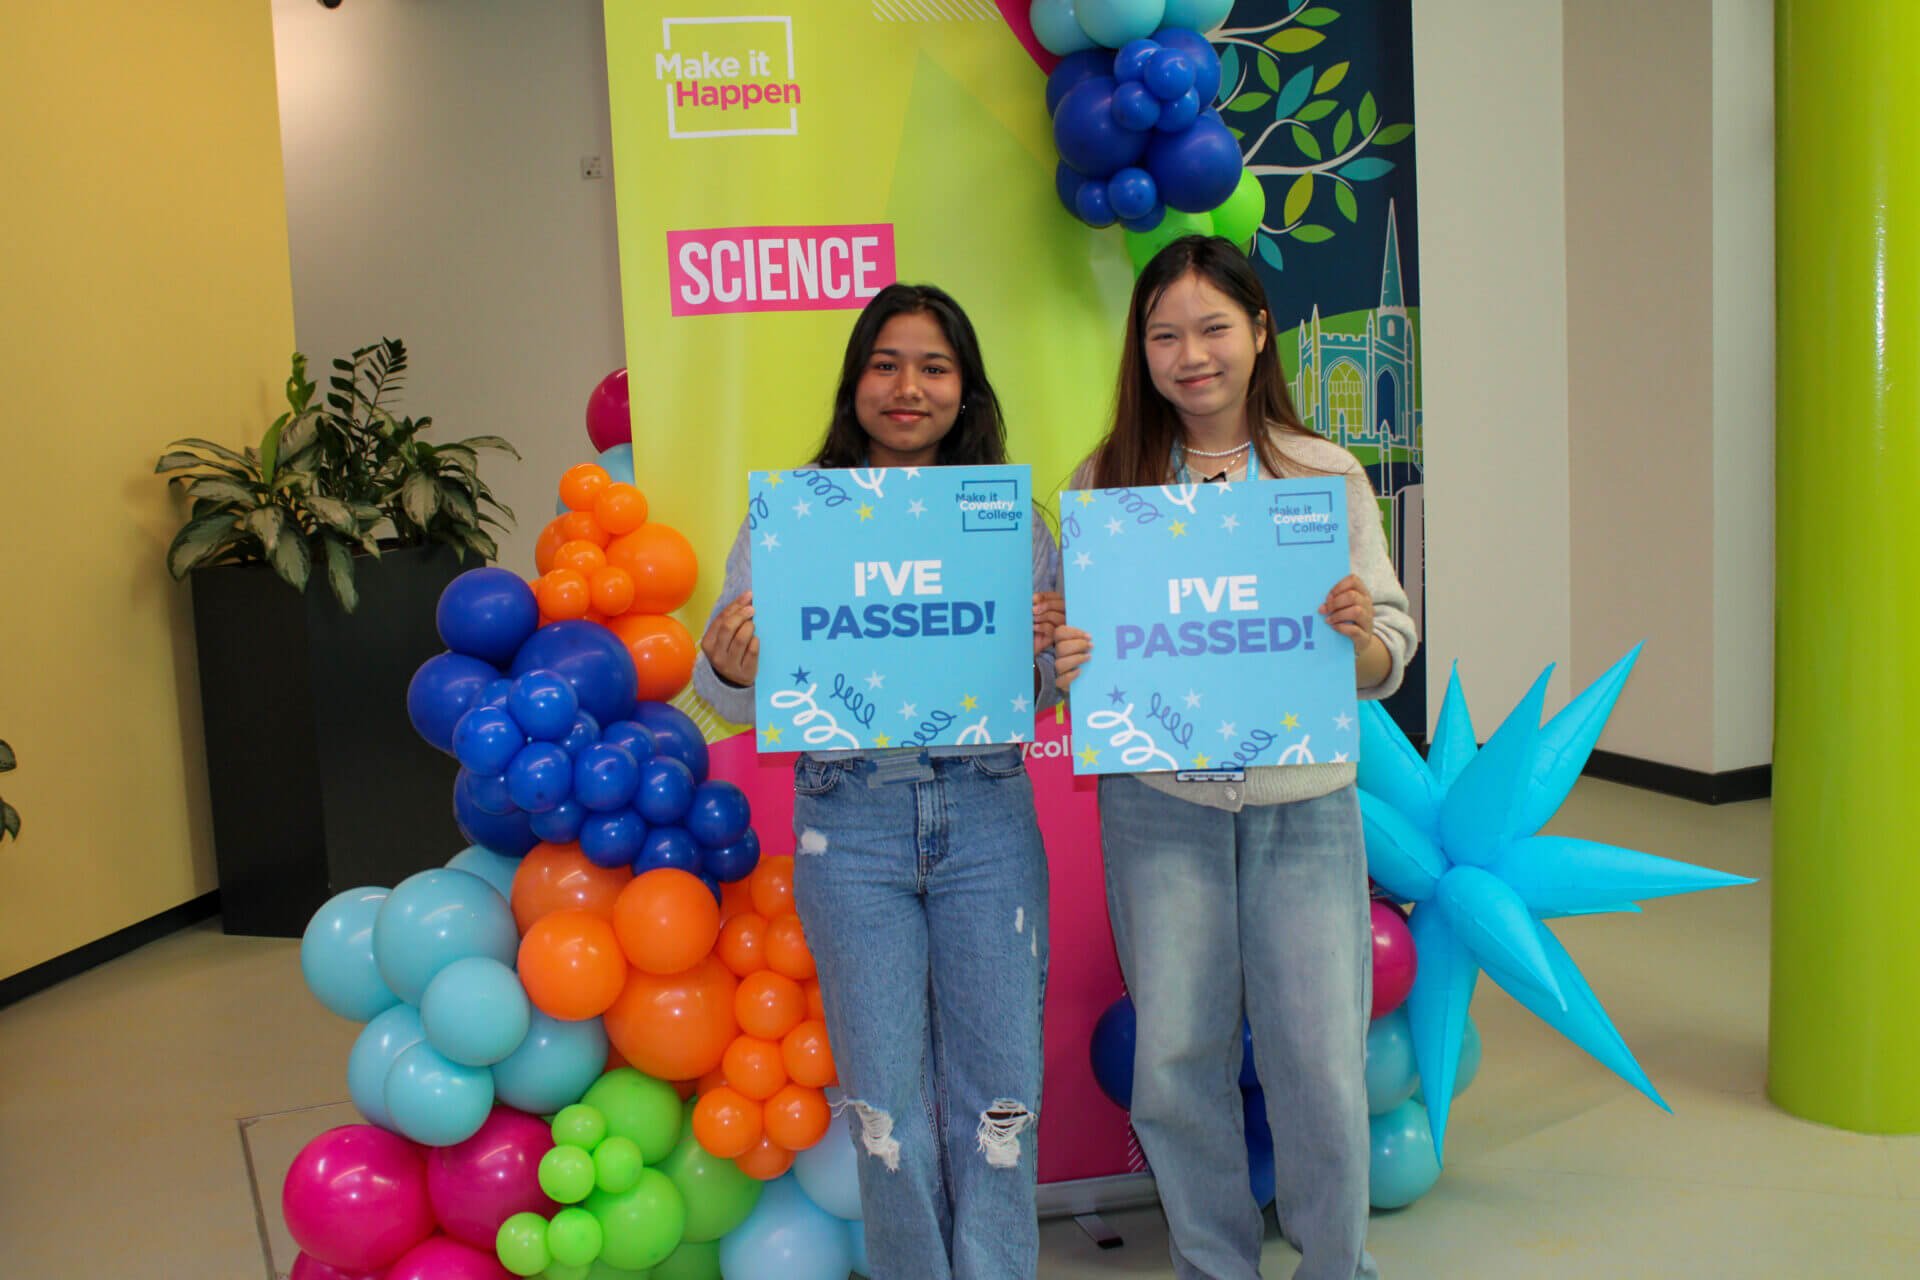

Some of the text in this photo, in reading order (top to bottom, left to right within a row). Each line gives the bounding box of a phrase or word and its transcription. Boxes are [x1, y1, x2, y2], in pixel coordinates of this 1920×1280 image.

[655, 50, 771, 80] Make it
[676, 80, 801, 111] Happen
[679, 236, 881, 305] SCIENCE
[955, 491, 998, 503] Make it
[960, 500, 1014, 512] Coventry
[1268, 503, 1312, 516] Make it
[977, 510, 1023, 521] College
[1273, 513, 1329, 525] Coventry
[1292, 522, 1339, 534] College
[800, 600, 996, 641] PASSED!
[1115, 614, 1316, 660] PASSED!
